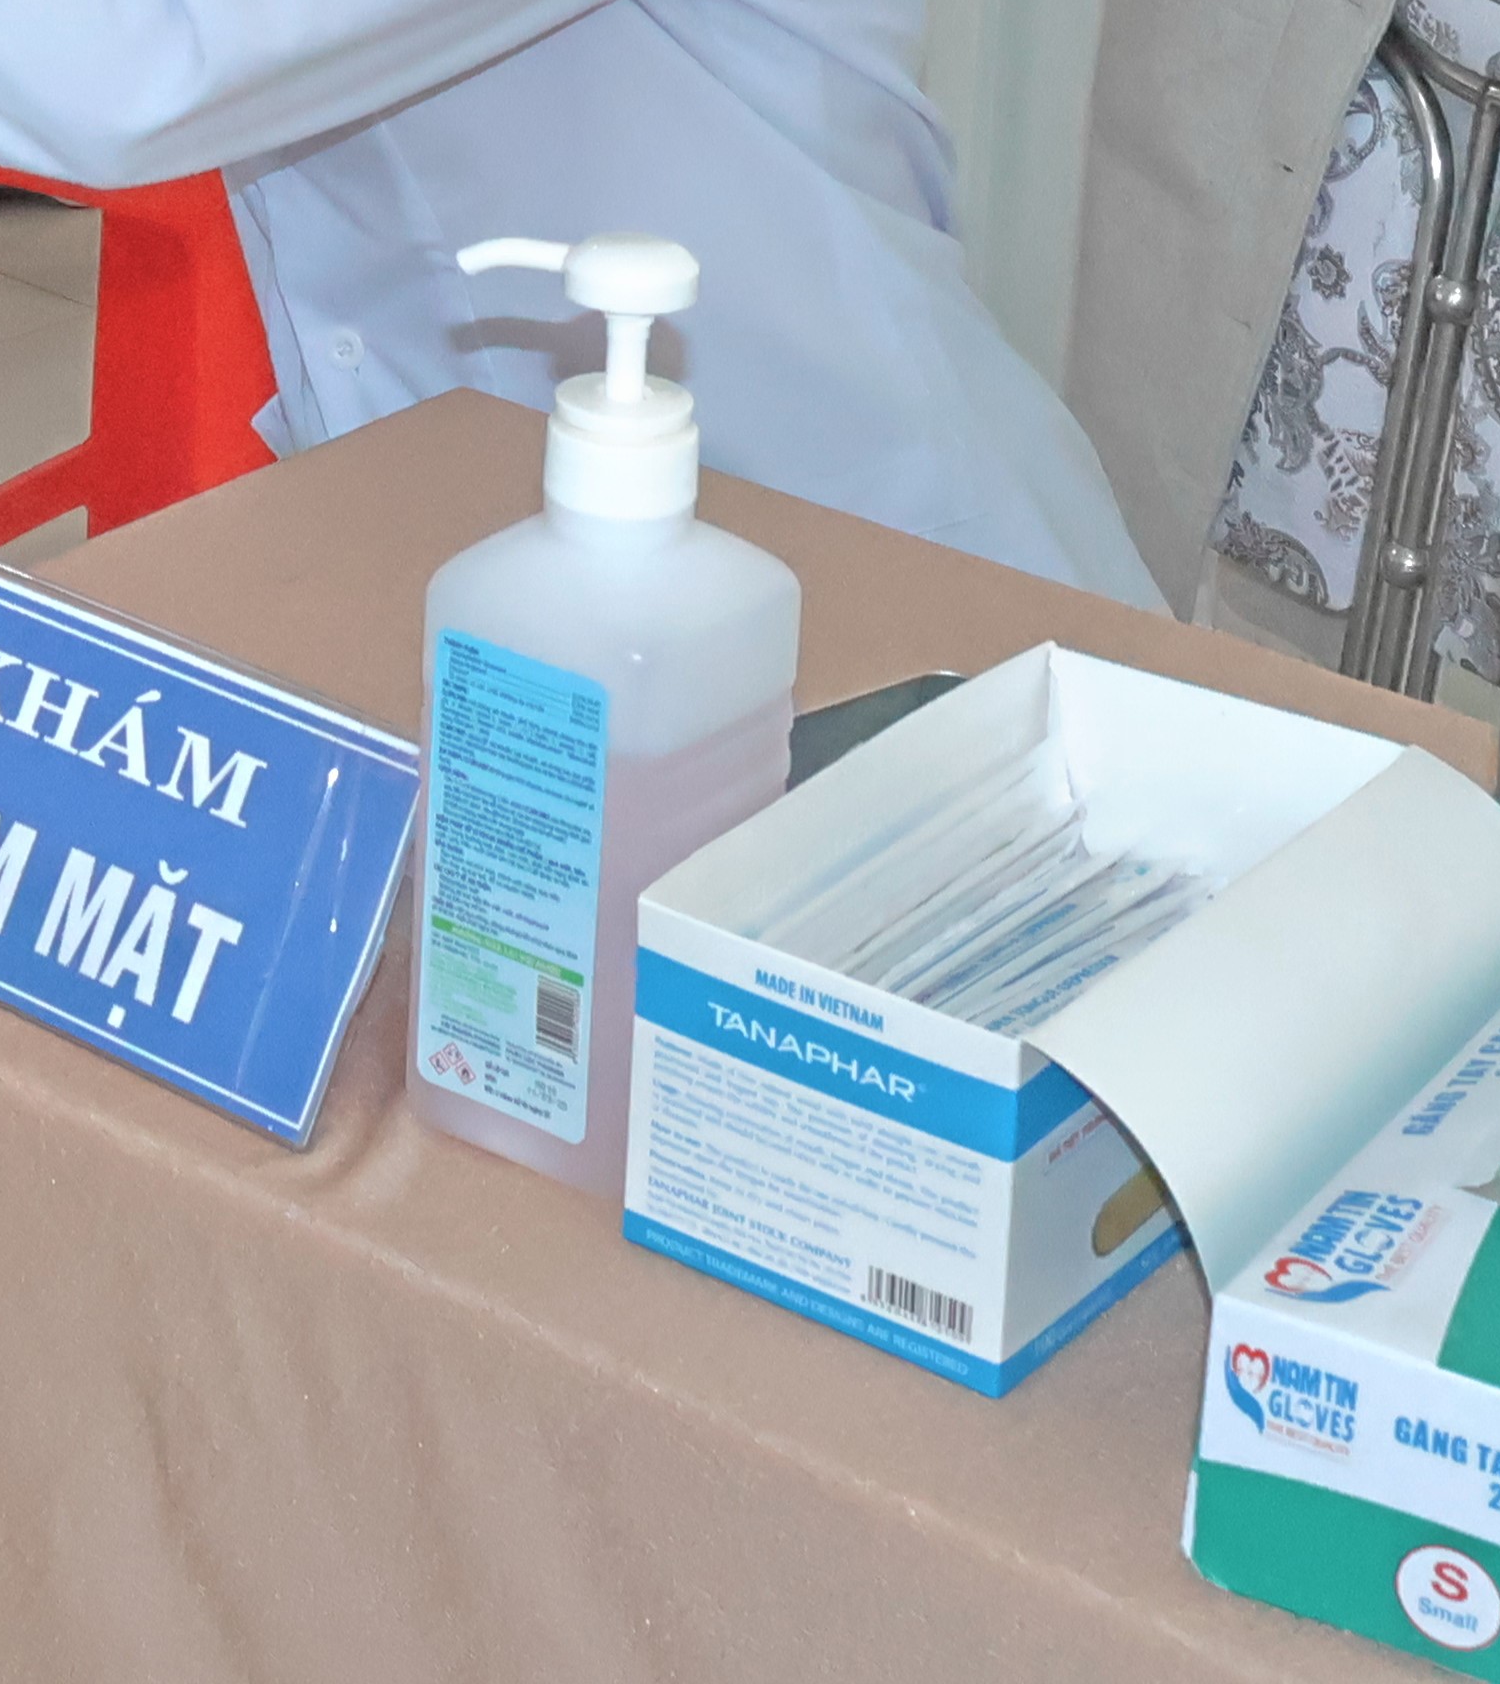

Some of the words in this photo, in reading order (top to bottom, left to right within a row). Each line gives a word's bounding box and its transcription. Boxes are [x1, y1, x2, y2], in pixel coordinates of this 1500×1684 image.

[36, 846, 244, 1029] MẶT
[754, 969, 797, 1002] MADE
[799, 983, 815, 1007] IN
[818, 991, 885, 1034] VIETNAM
[707, 1000, 916, 1104] TANAPHAR
[1447, 1059, 1496, 1087] TAY
[1334, 1194, 1423, 1276] GLOVES
[1267, 1388, 1355, 1444] GLOVES
[1431, 1561, 1469, 1603] S
[1418, 1596, 1479, 1633] Small
